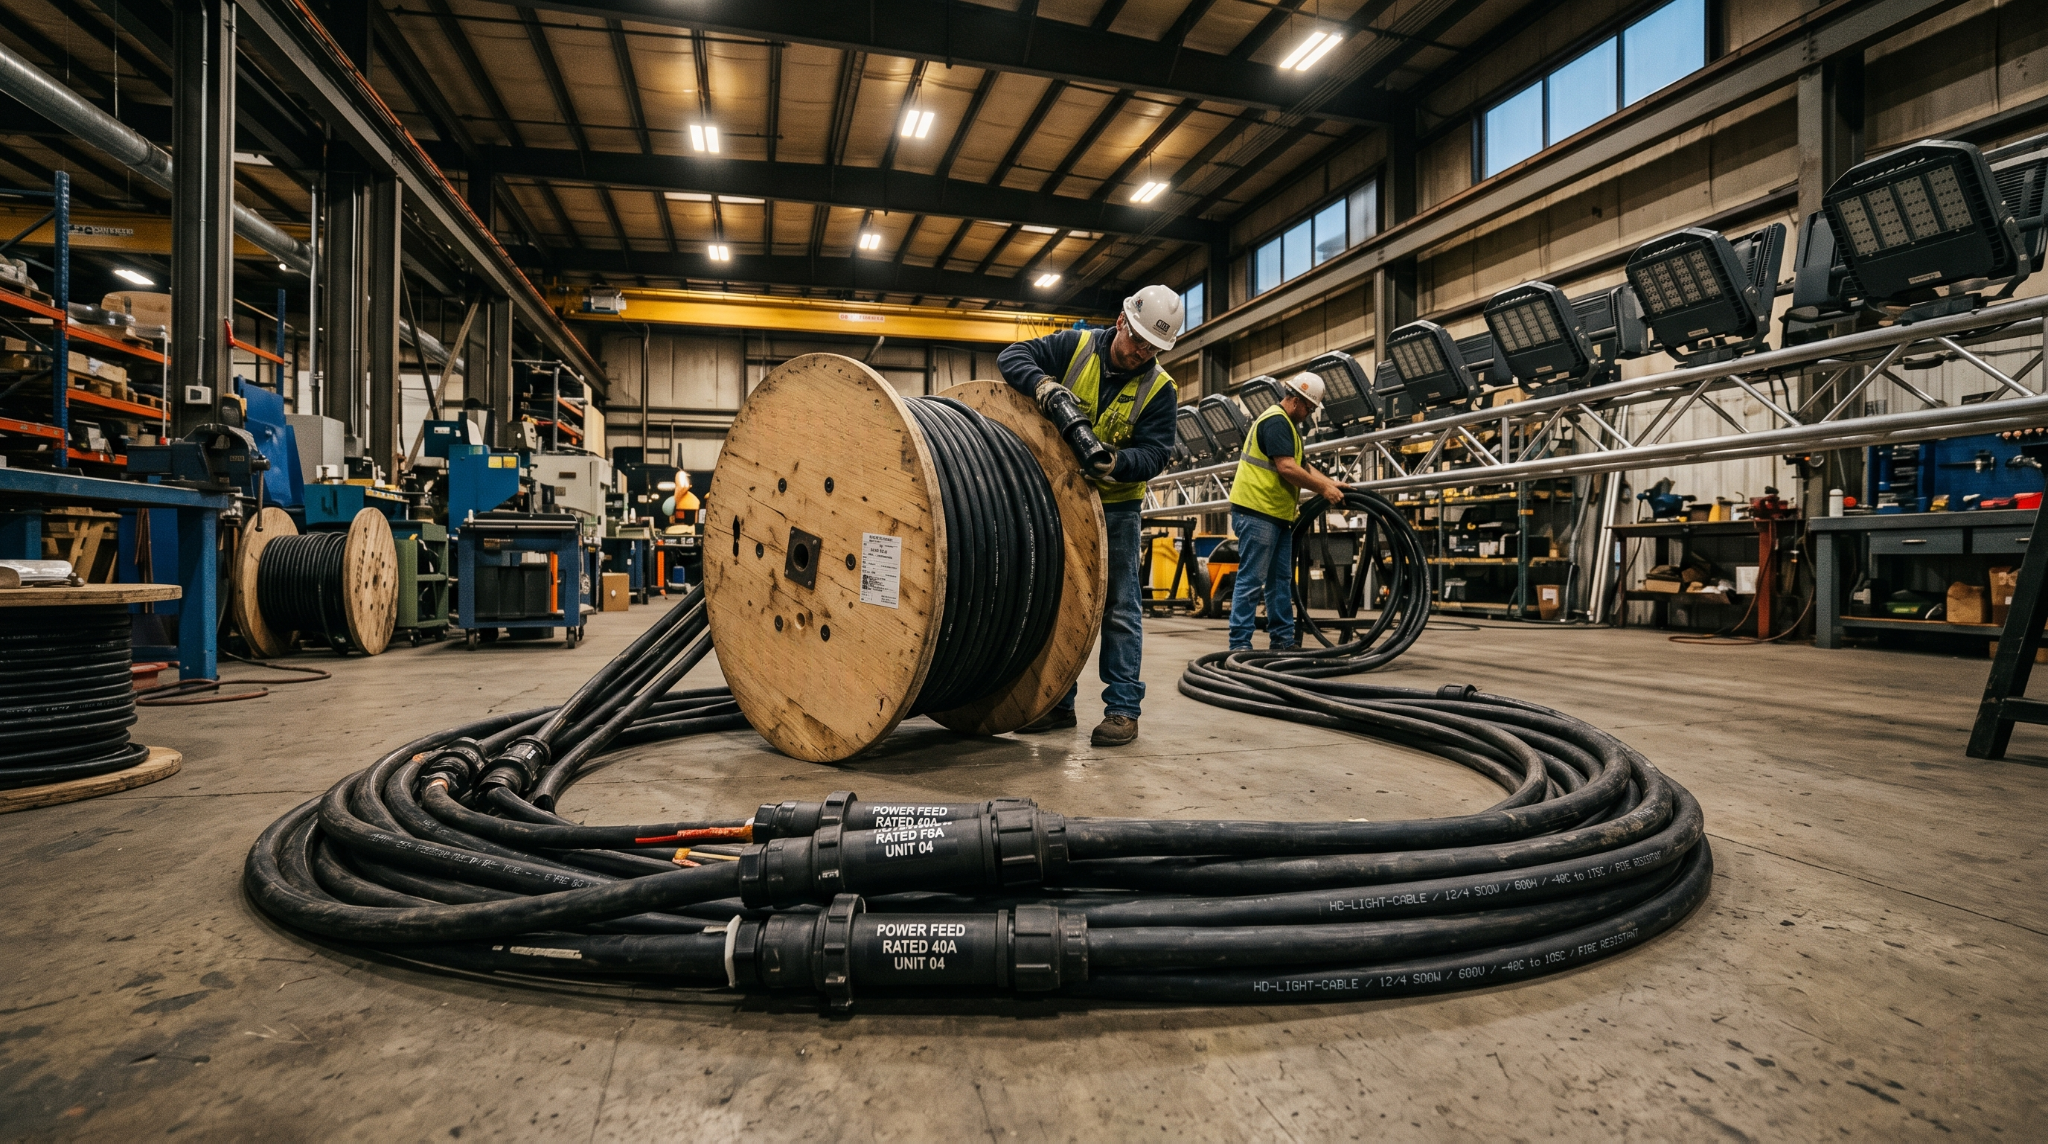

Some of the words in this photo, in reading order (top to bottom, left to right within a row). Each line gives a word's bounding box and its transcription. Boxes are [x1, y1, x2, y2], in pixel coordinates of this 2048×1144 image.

[872, 806, 915, 816] POWER
[916, 806, 948, 816] FEED
[875, 816, 914, 828] RATED
[875, 830, 917, 845] RATED
[885, 842, 915, 857] UNIT
[918, 840, 934, 854] 04
[1445, 888, 1470, 901] 12/4
[1573, 871, 1585, 881] to
[876, 923, 927, 937] POWER
[930, 923, 966, 937] FEED
[882, 939, 929, 954] RATED
[931, 939, 957, 954] 40A
[894, 956, 926, 970] UNIT
[929, 956, 945, 970] 04
[1253, 978, 1359, 992] HD-LIGHT-CABLE
[1380, 974, 1407, 987] 12/4
[1529, 957, 1541, 967] to
